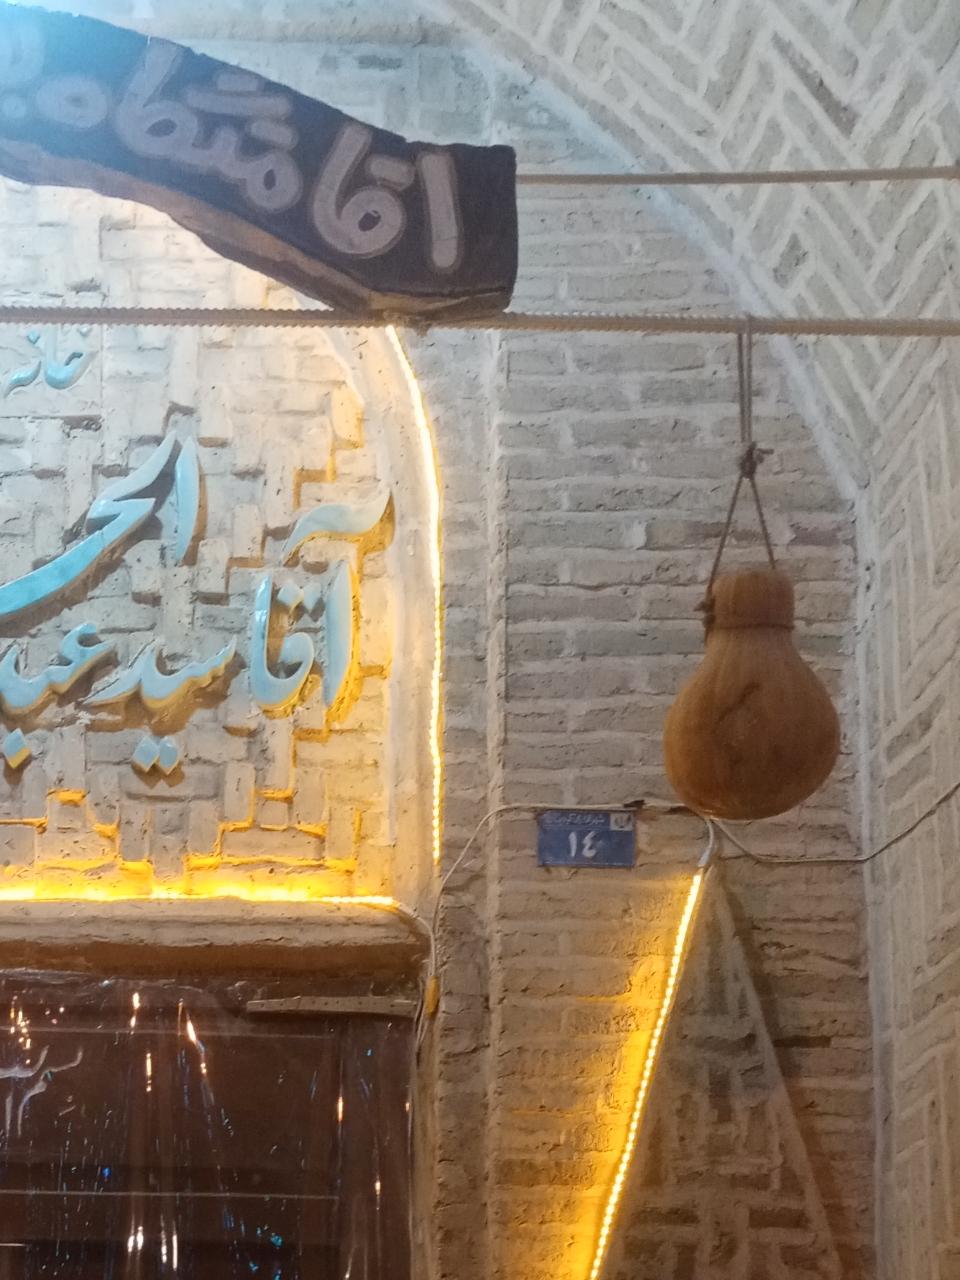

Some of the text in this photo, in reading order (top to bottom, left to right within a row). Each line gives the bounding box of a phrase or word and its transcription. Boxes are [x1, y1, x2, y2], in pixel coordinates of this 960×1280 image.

[36, 37, 464, 276] اقامتگاه
[2, 321, 99, 399] خانه
[80, 636, 239, 774] سید
